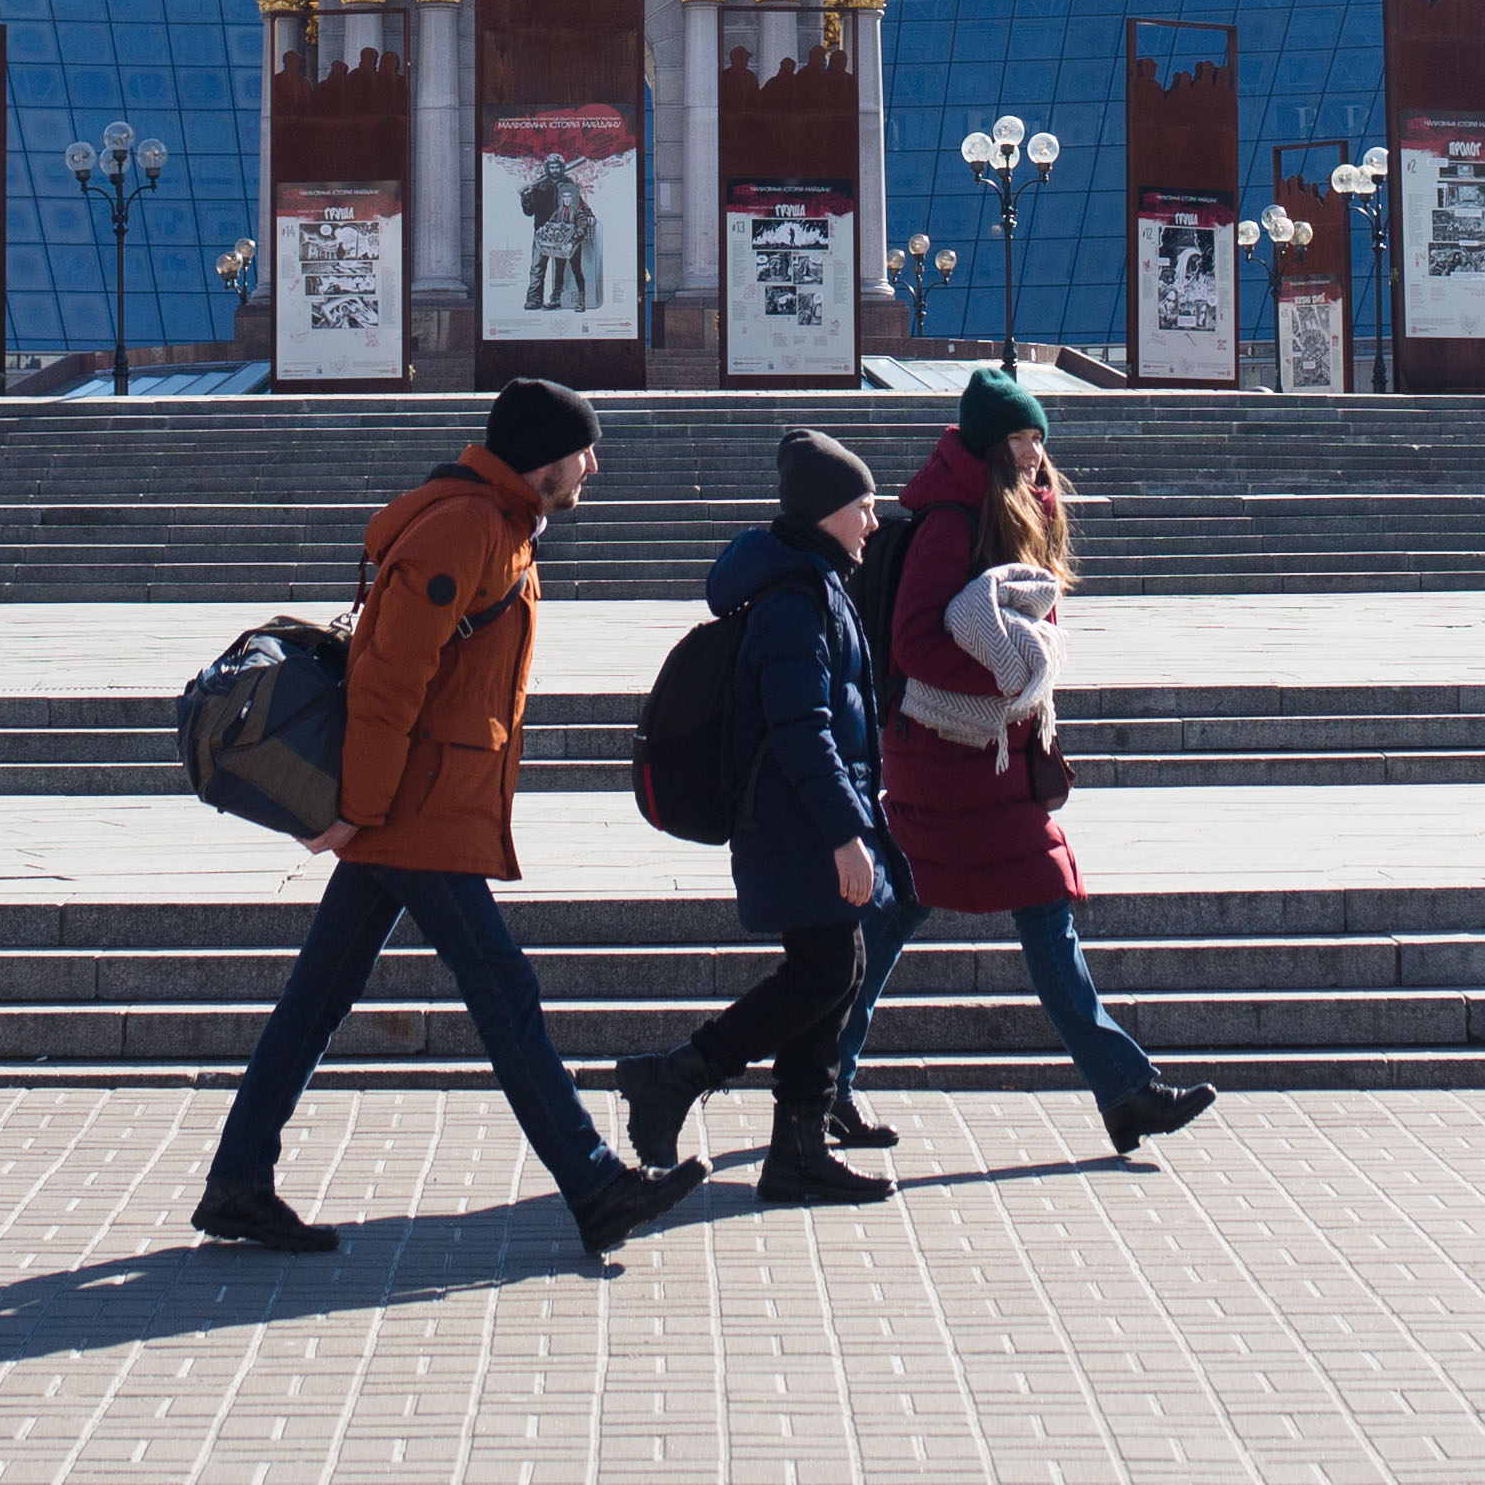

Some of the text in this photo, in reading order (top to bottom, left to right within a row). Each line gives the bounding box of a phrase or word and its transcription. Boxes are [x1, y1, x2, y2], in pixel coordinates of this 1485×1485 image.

[1448, 141, 1482, 157] ПРОЛОГ
[324, 207, 355, 221] ГРУША
[775, 203, 806, 217] ГРУША
